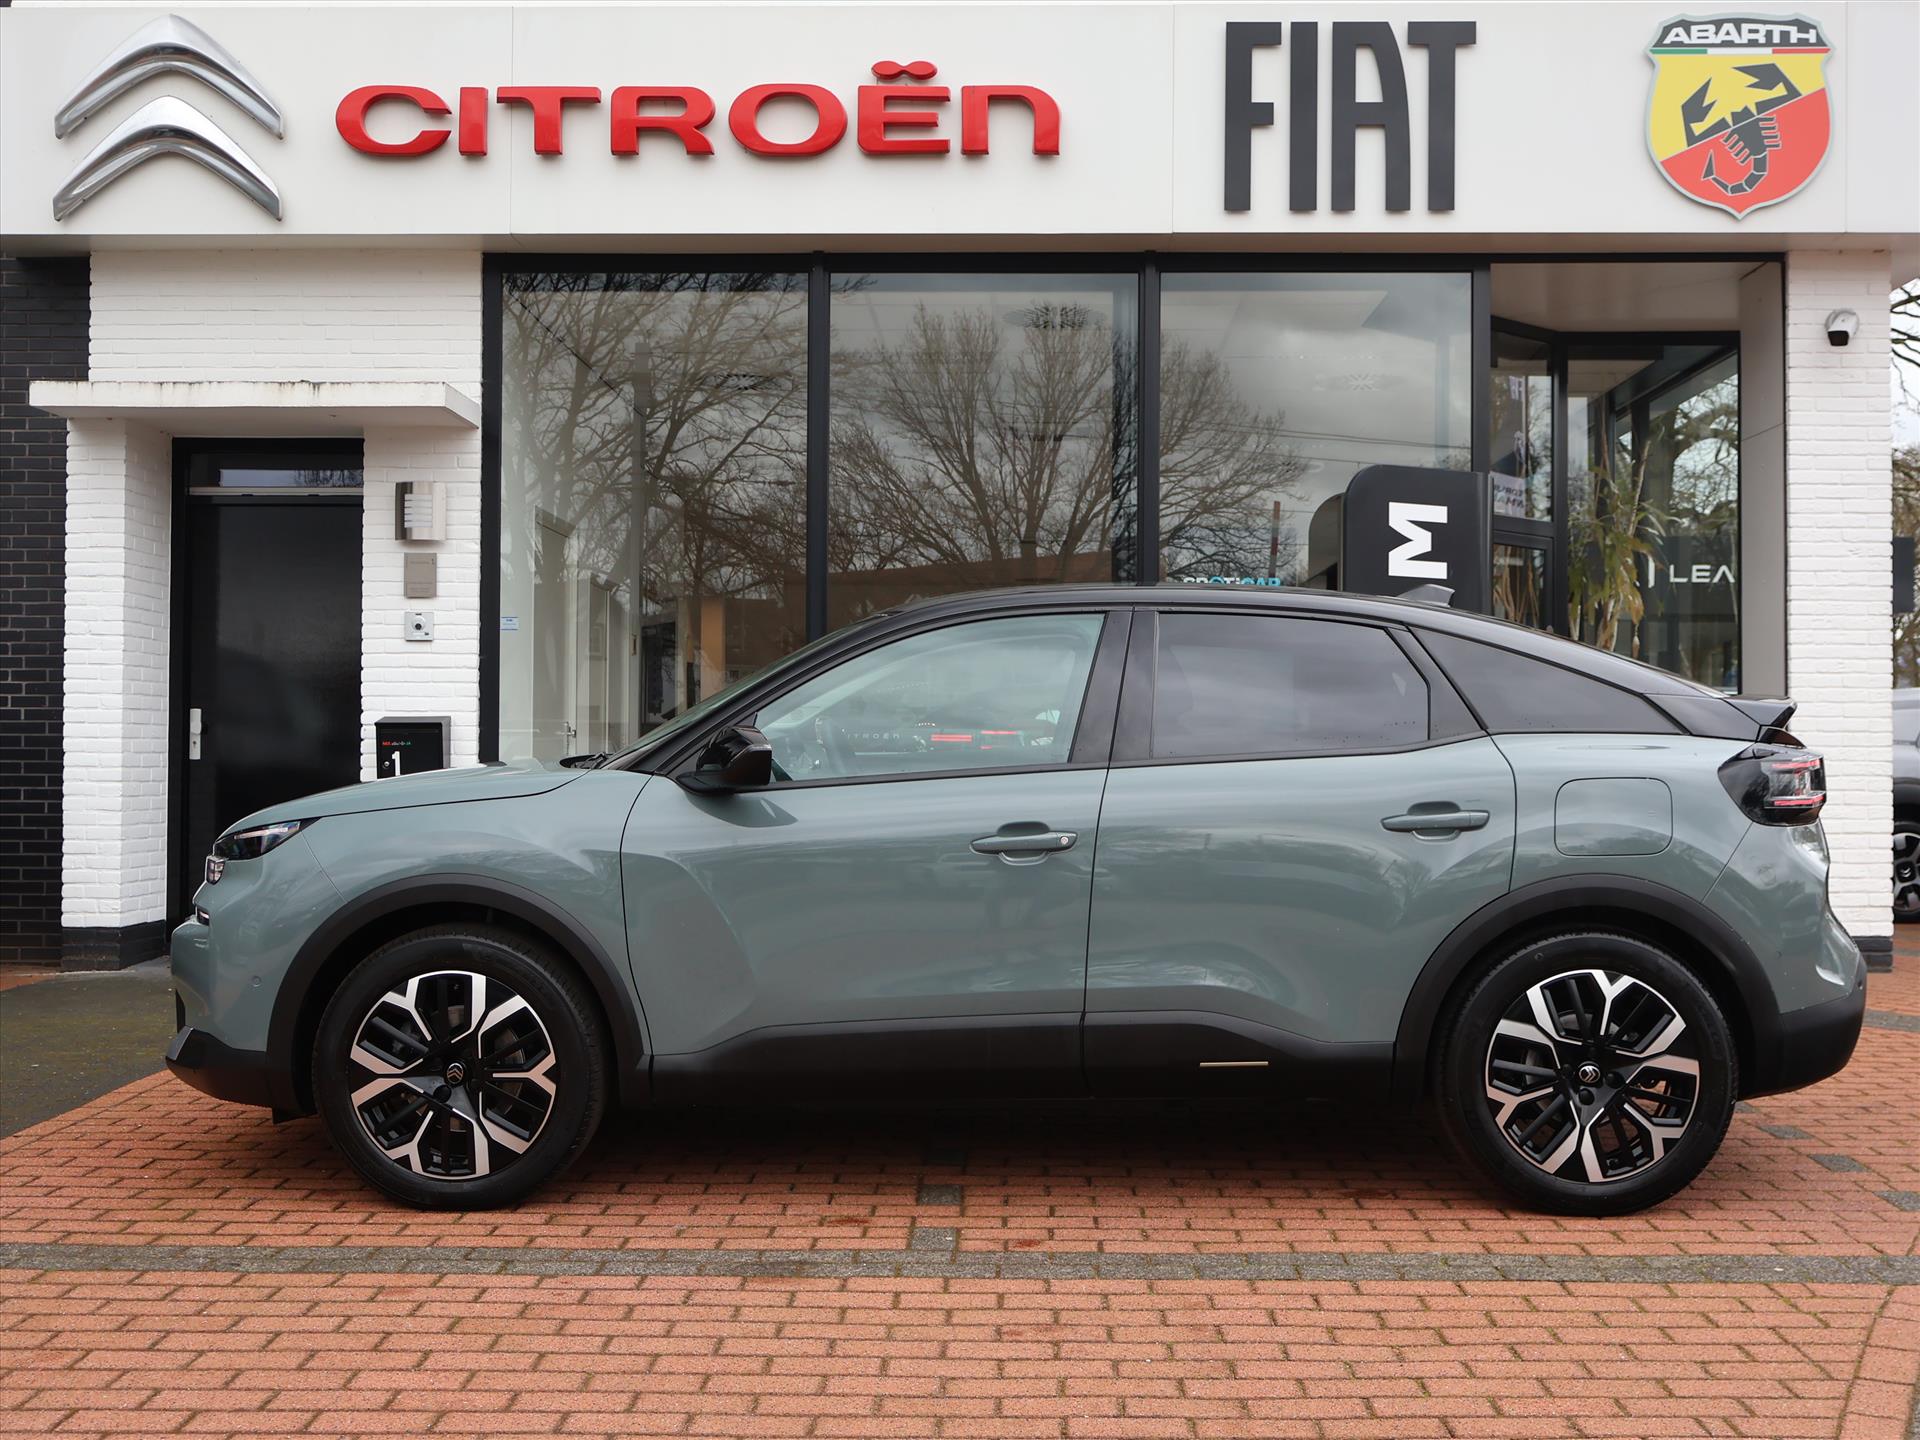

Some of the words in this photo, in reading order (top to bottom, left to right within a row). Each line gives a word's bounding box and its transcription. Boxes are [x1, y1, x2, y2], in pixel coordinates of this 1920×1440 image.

[1663, 23, 1817, 44] ABARTH
[1224, 21, 1477, 211] FIAT
[391, 750, 401, 776] 1
